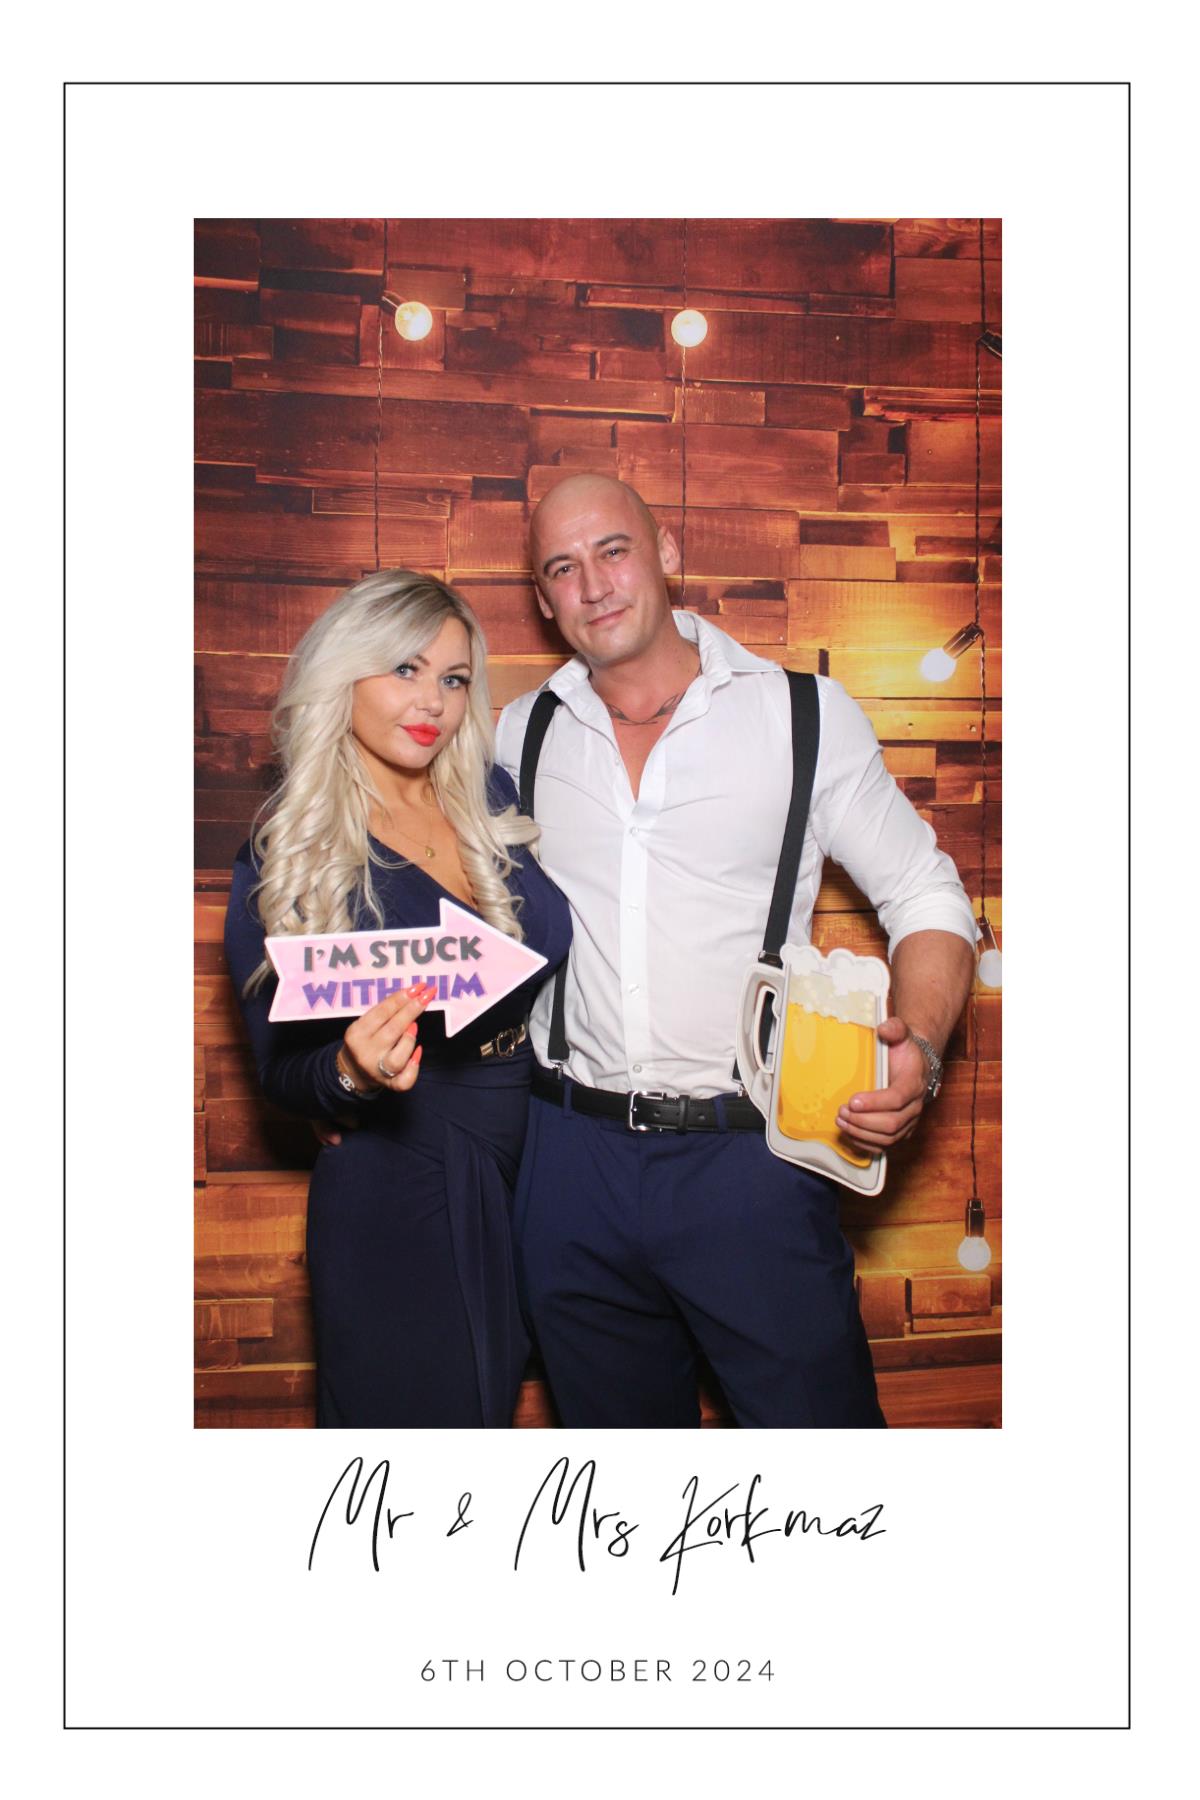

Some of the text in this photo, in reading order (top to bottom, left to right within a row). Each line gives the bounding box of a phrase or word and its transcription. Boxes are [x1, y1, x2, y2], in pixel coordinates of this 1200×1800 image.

[303, 935, 484, 973] I'M STUCK
[302, 978, 402, 1010] WITH
